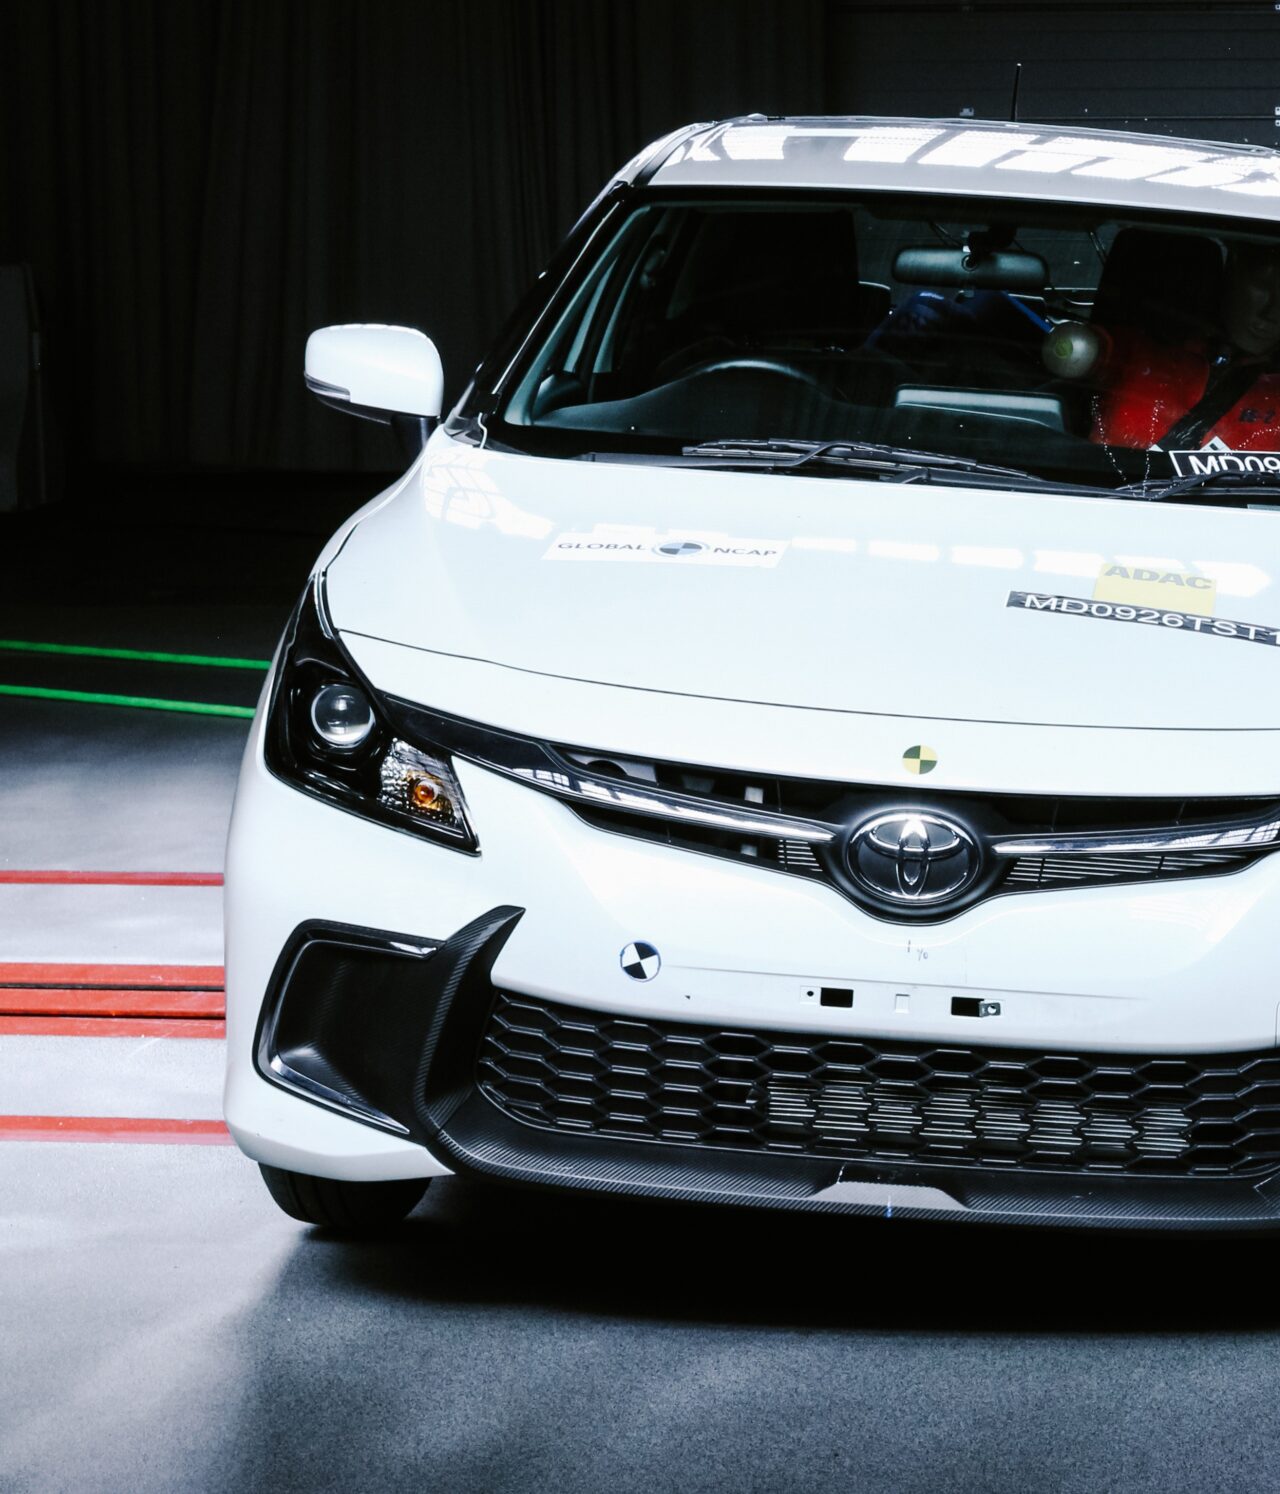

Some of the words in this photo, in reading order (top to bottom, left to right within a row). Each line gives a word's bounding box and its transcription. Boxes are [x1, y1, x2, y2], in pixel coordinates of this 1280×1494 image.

[557, 542, 646, 551] GLOBAL
[712, 547, 778, 556] NCAP
[1103, 565, 1213, 590] ADAC
